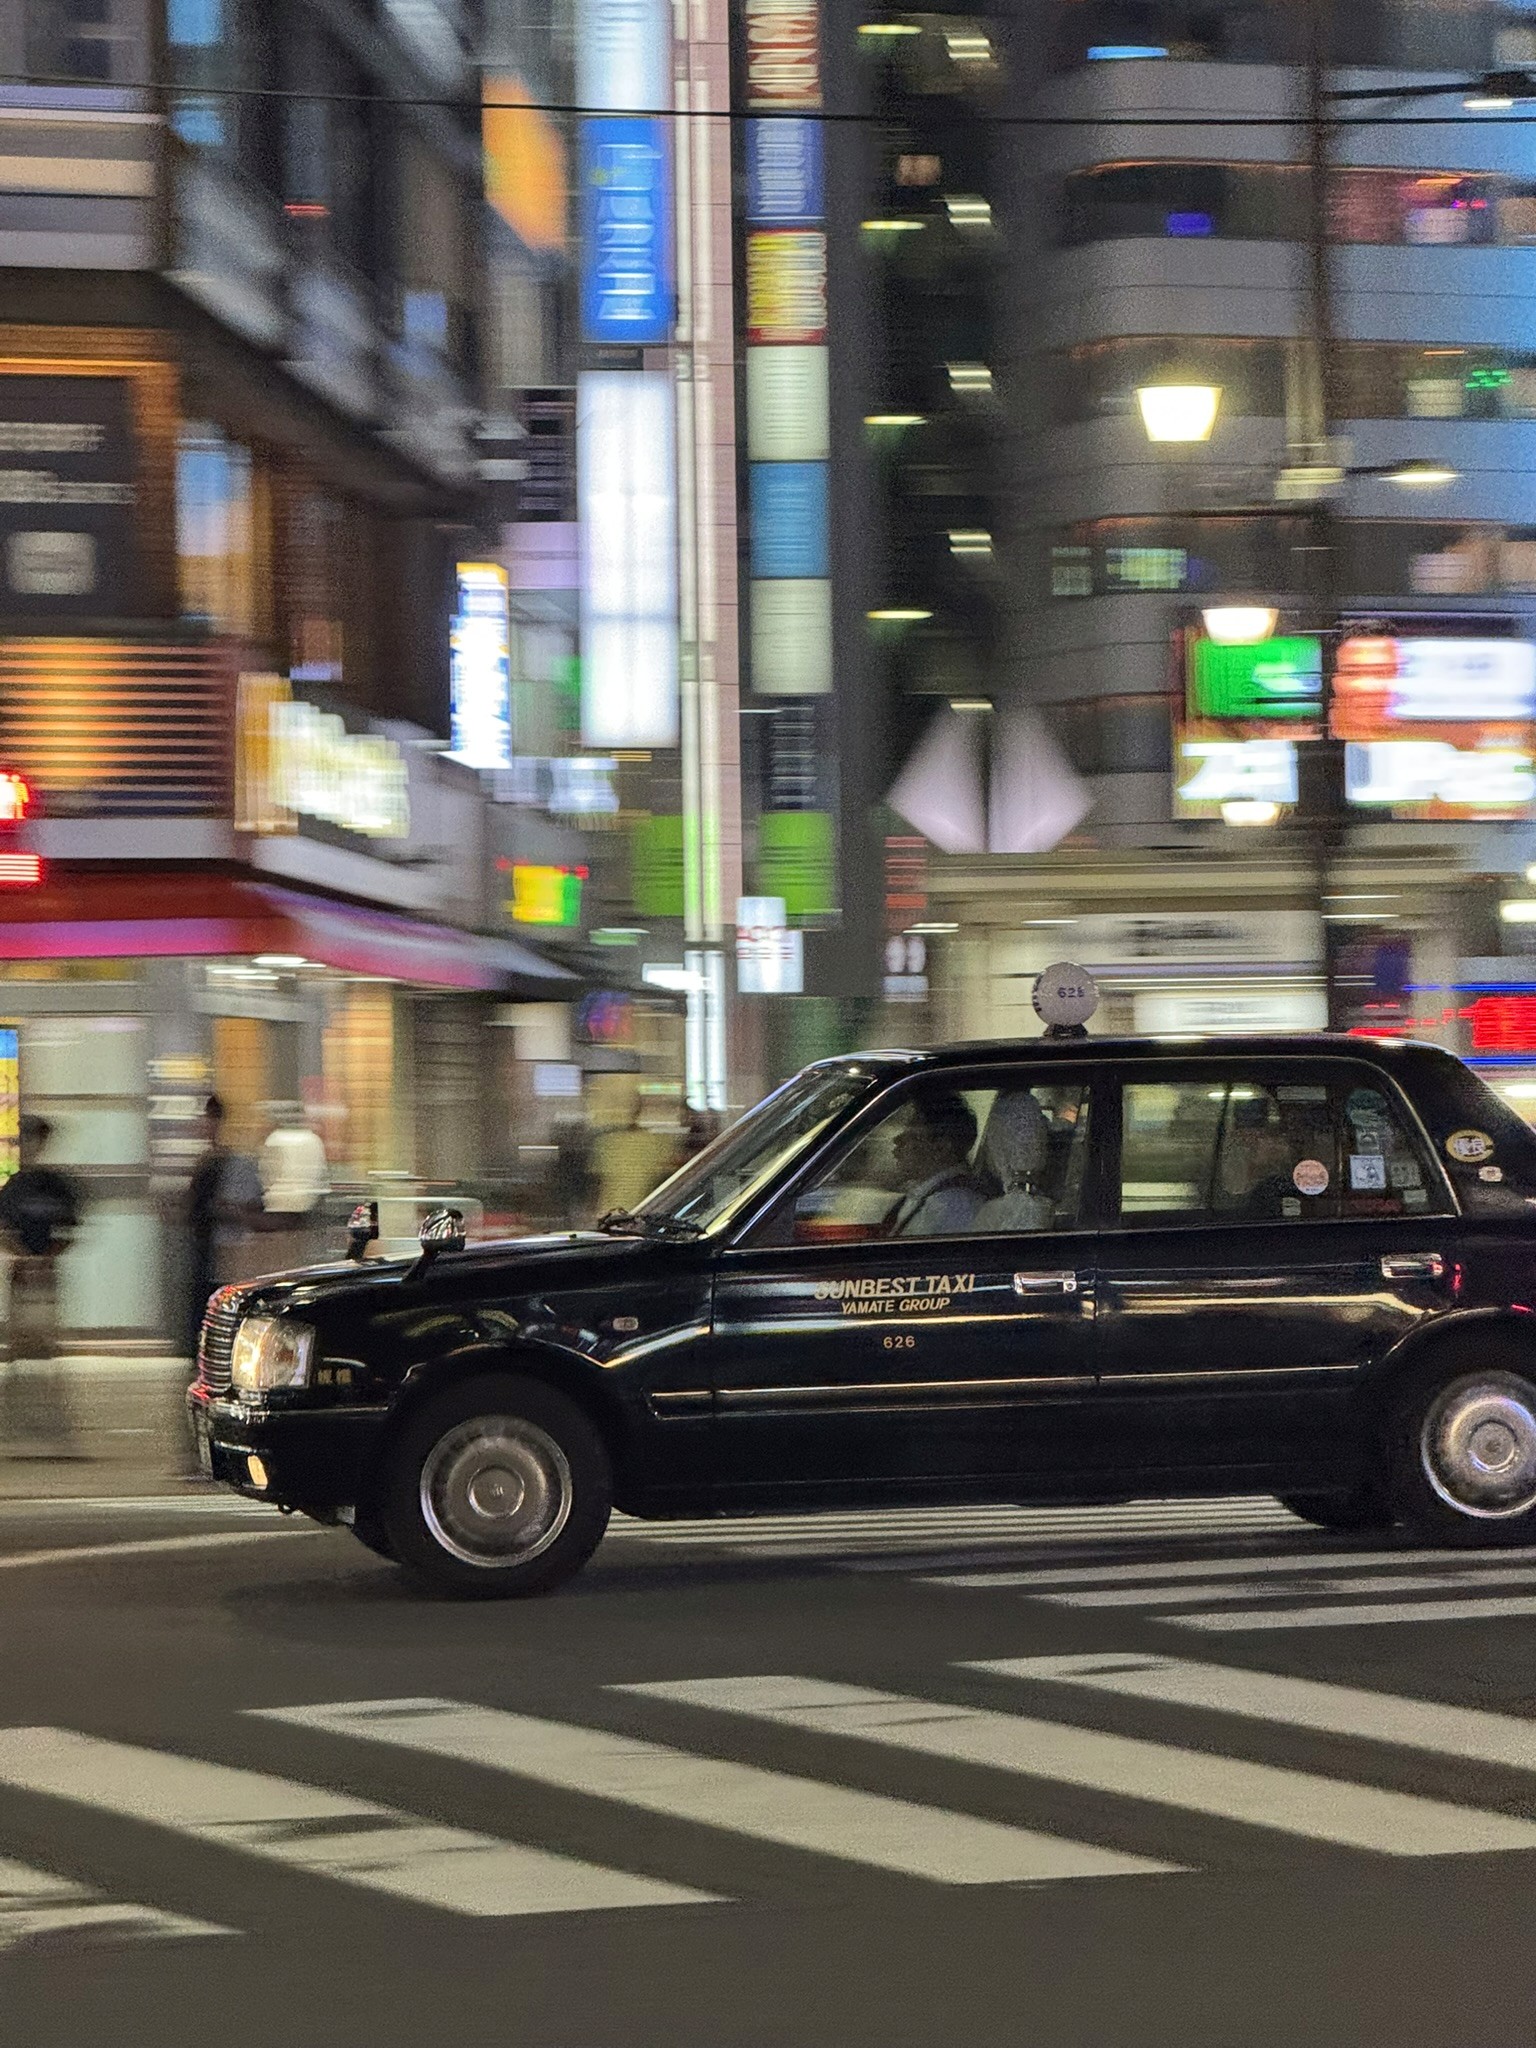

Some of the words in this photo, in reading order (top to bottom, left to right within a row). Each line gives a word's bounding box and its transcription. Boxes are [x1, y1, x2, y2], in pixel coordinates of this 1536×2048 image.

[926, 1273, 975, 1294] TAXI
[841, 1299, 895, 1315] YAMATE
[899, 1297, 950, 1312] GROUP
[883, 1335, 916, 1349] 626
